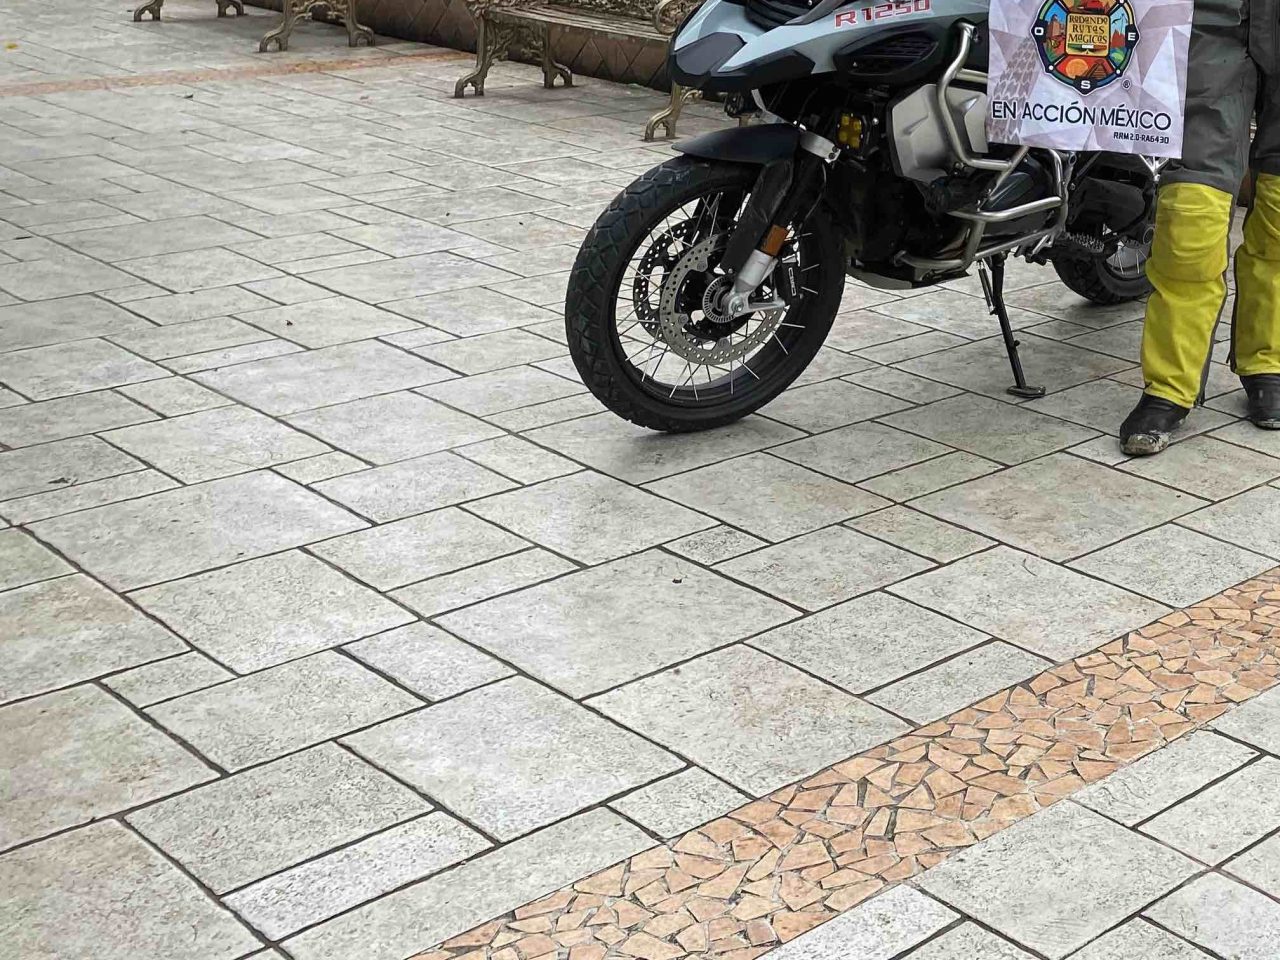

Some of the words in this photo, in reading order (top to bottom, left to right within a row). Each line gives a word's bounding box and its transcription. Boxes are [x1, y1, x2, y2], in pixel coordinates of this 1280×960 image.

[835, 11, 857, 28] R
[1128, 32, 1136, 41] E
[1080, 80, 1091, 89] S
[992, 101, 1017, 119] EN
[1022, 101, 1096, 125] ACCIÓN
[1100, 105, 1172, 131] MÉXICO
